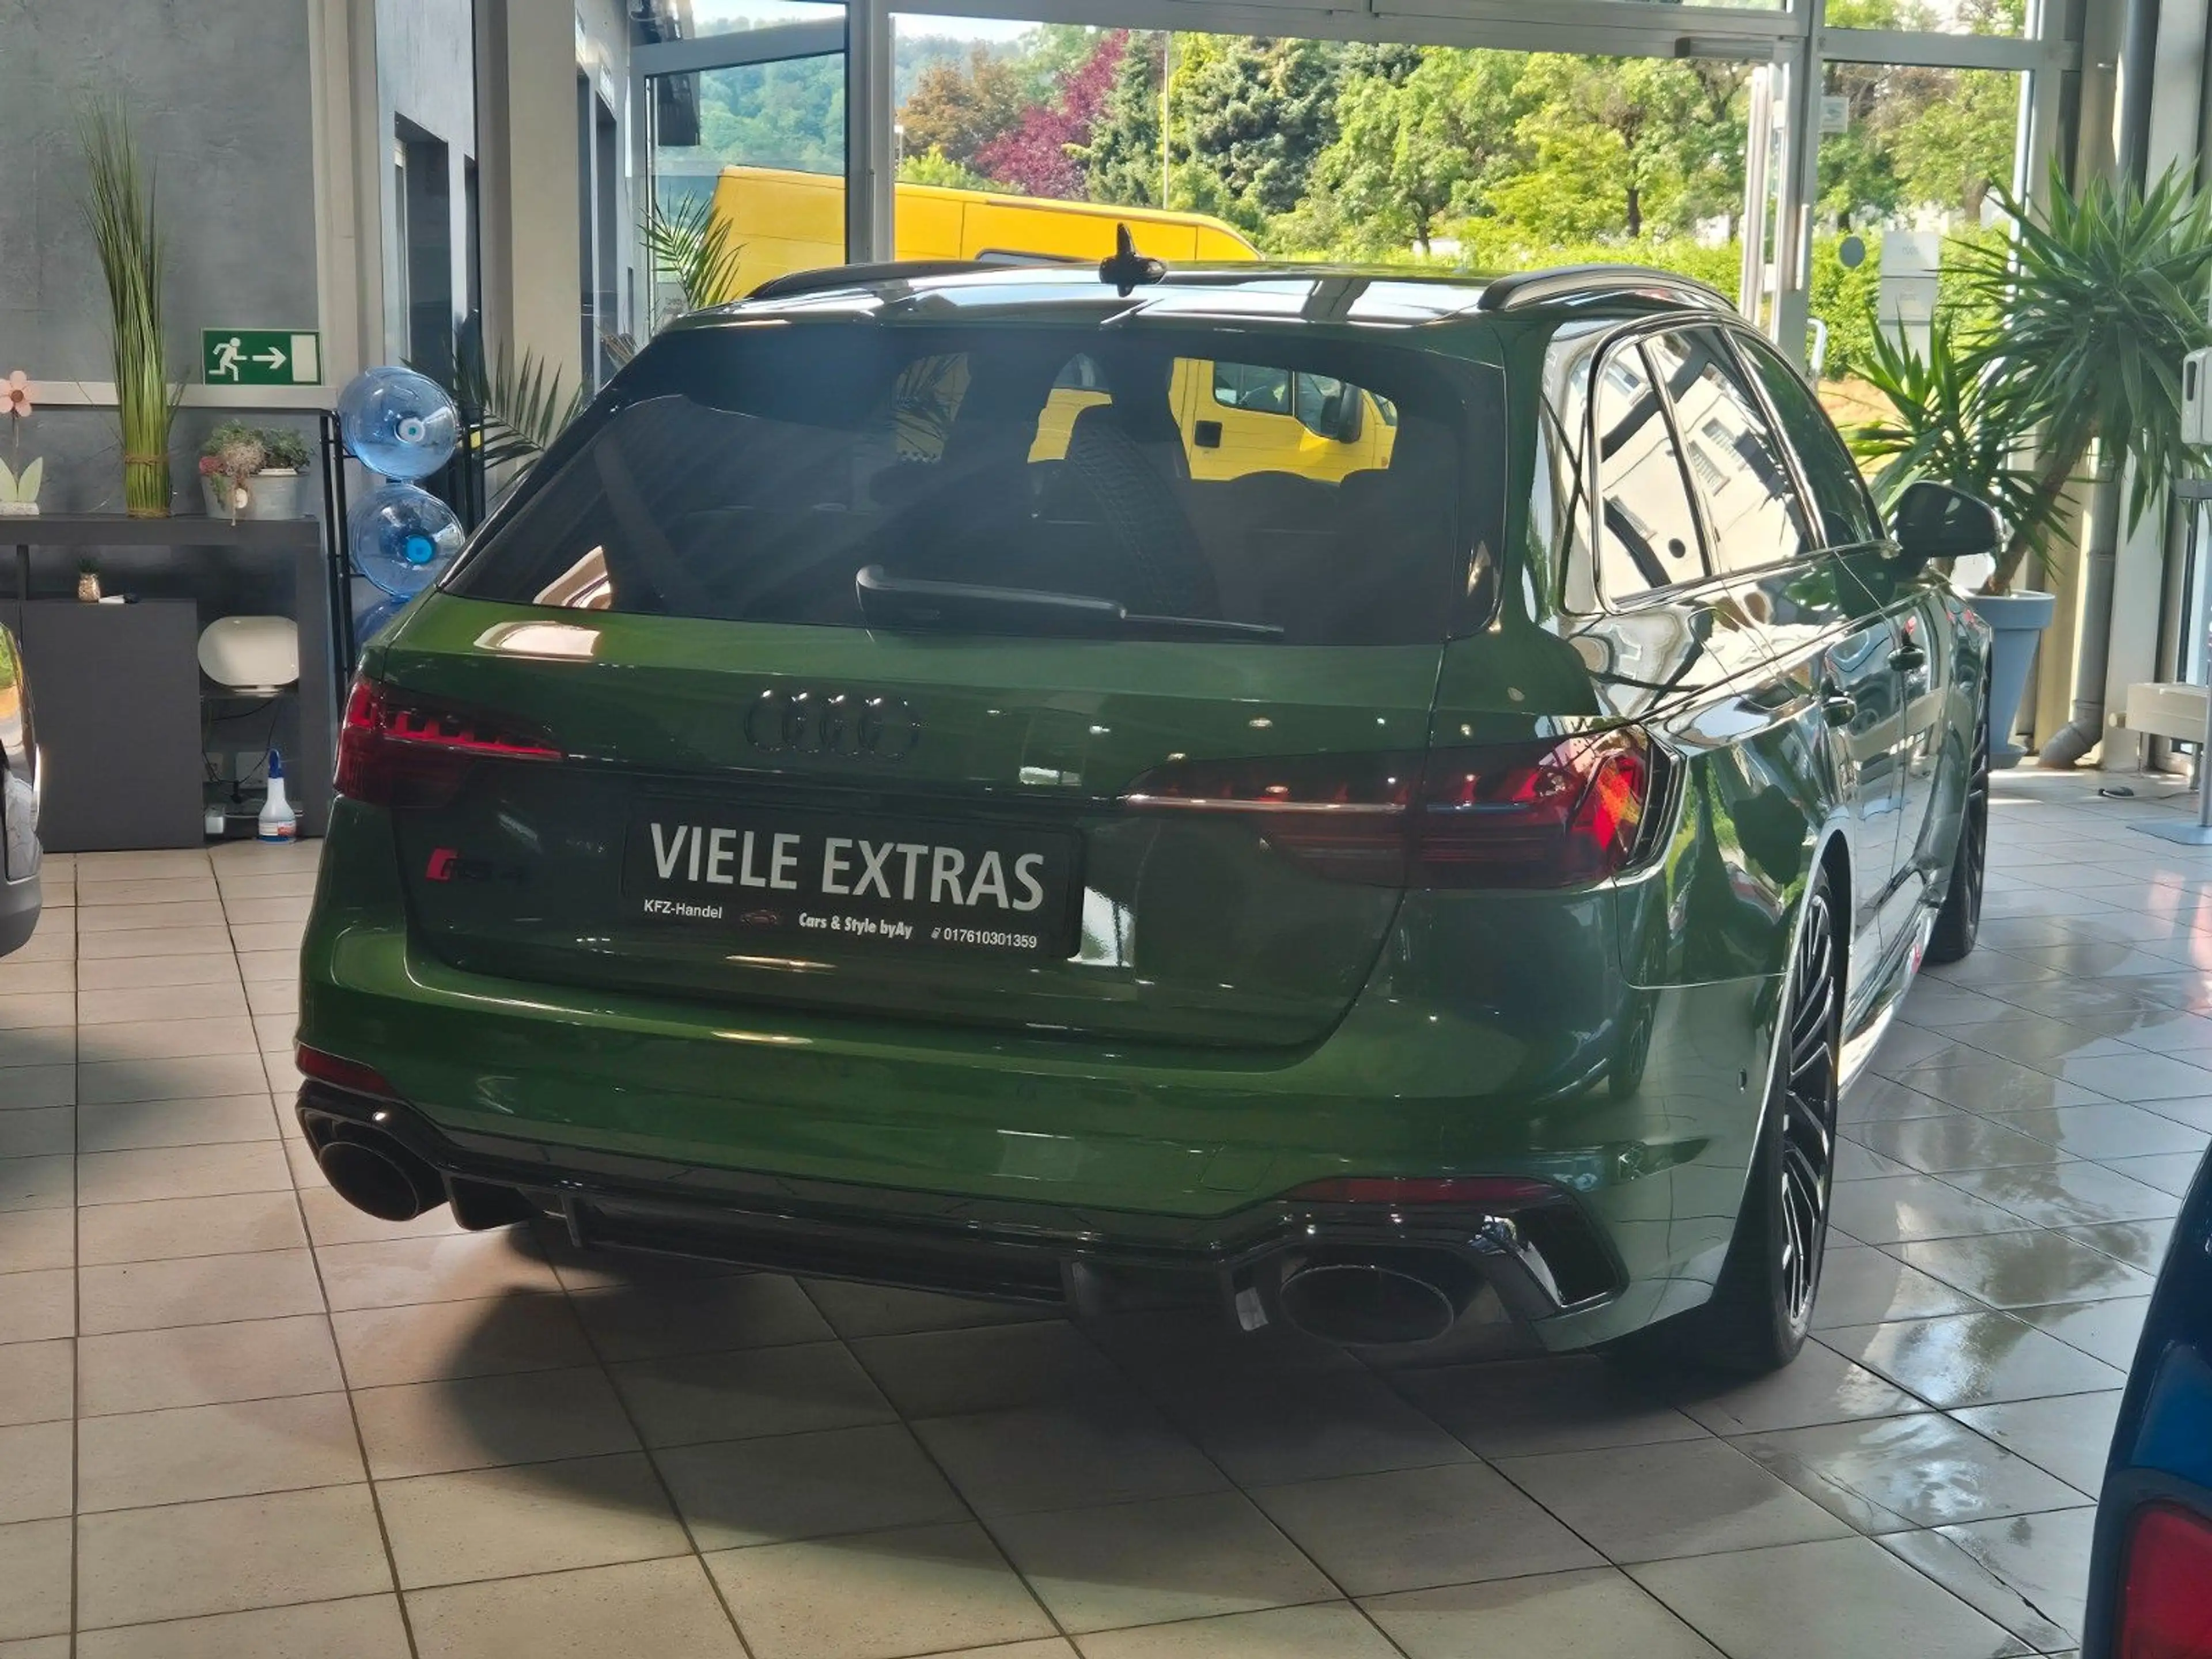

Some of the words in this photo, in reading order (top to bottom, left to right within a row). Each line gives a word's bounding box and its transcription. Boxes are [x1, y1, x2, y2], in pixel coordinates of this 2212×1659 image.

[651, 823, 800, 889] VIELE
[822, 838, 1043, 911] EXTRAS
[644, 899, 722, 919] KFZ-Handel
[798, 912, 827, 929] Cars
[831, 915, 841, 930] &
[844, 916, 877, 935] Style
[944, 927, 1037, 949] 017610301359
